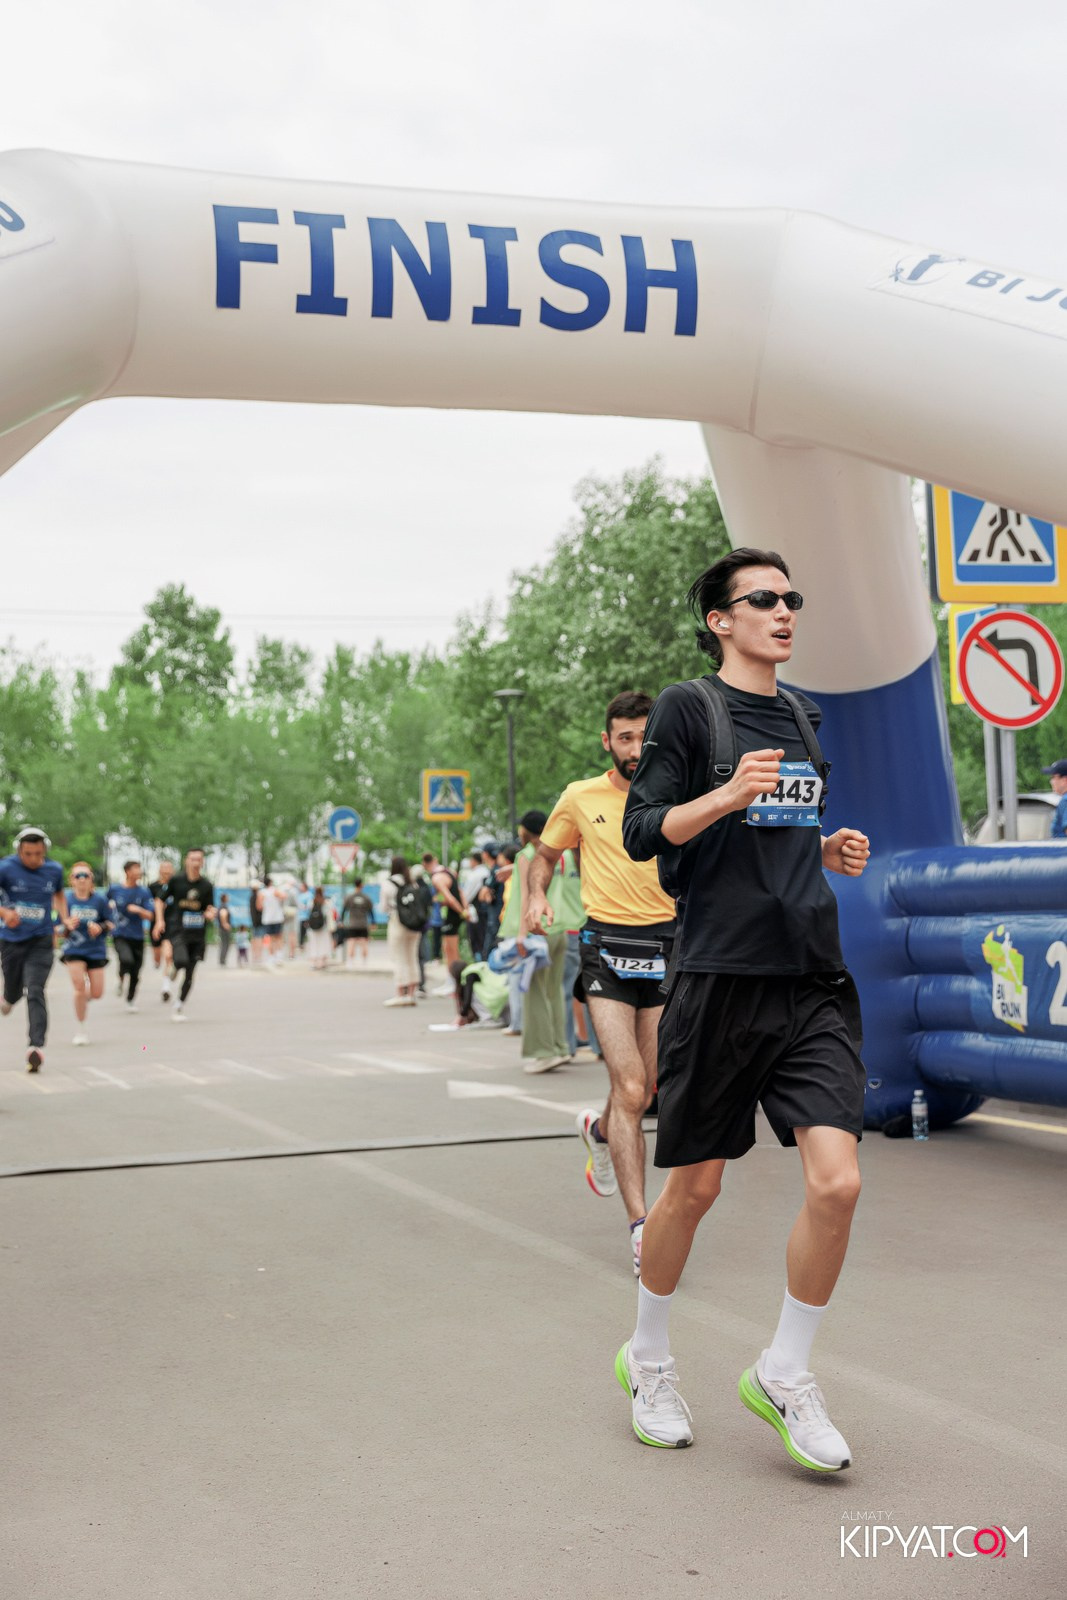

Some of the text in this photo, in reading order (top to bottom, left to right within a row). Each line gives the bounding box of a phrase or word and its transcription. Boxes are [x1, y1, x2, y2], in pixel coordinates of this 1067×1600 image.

[213, 204, 699, 337] FINISH
[966, 269, 1025, 294] BI
[611, 957, 654, 971] 1124
[1000, 1001, 1022, 1019] RUN
